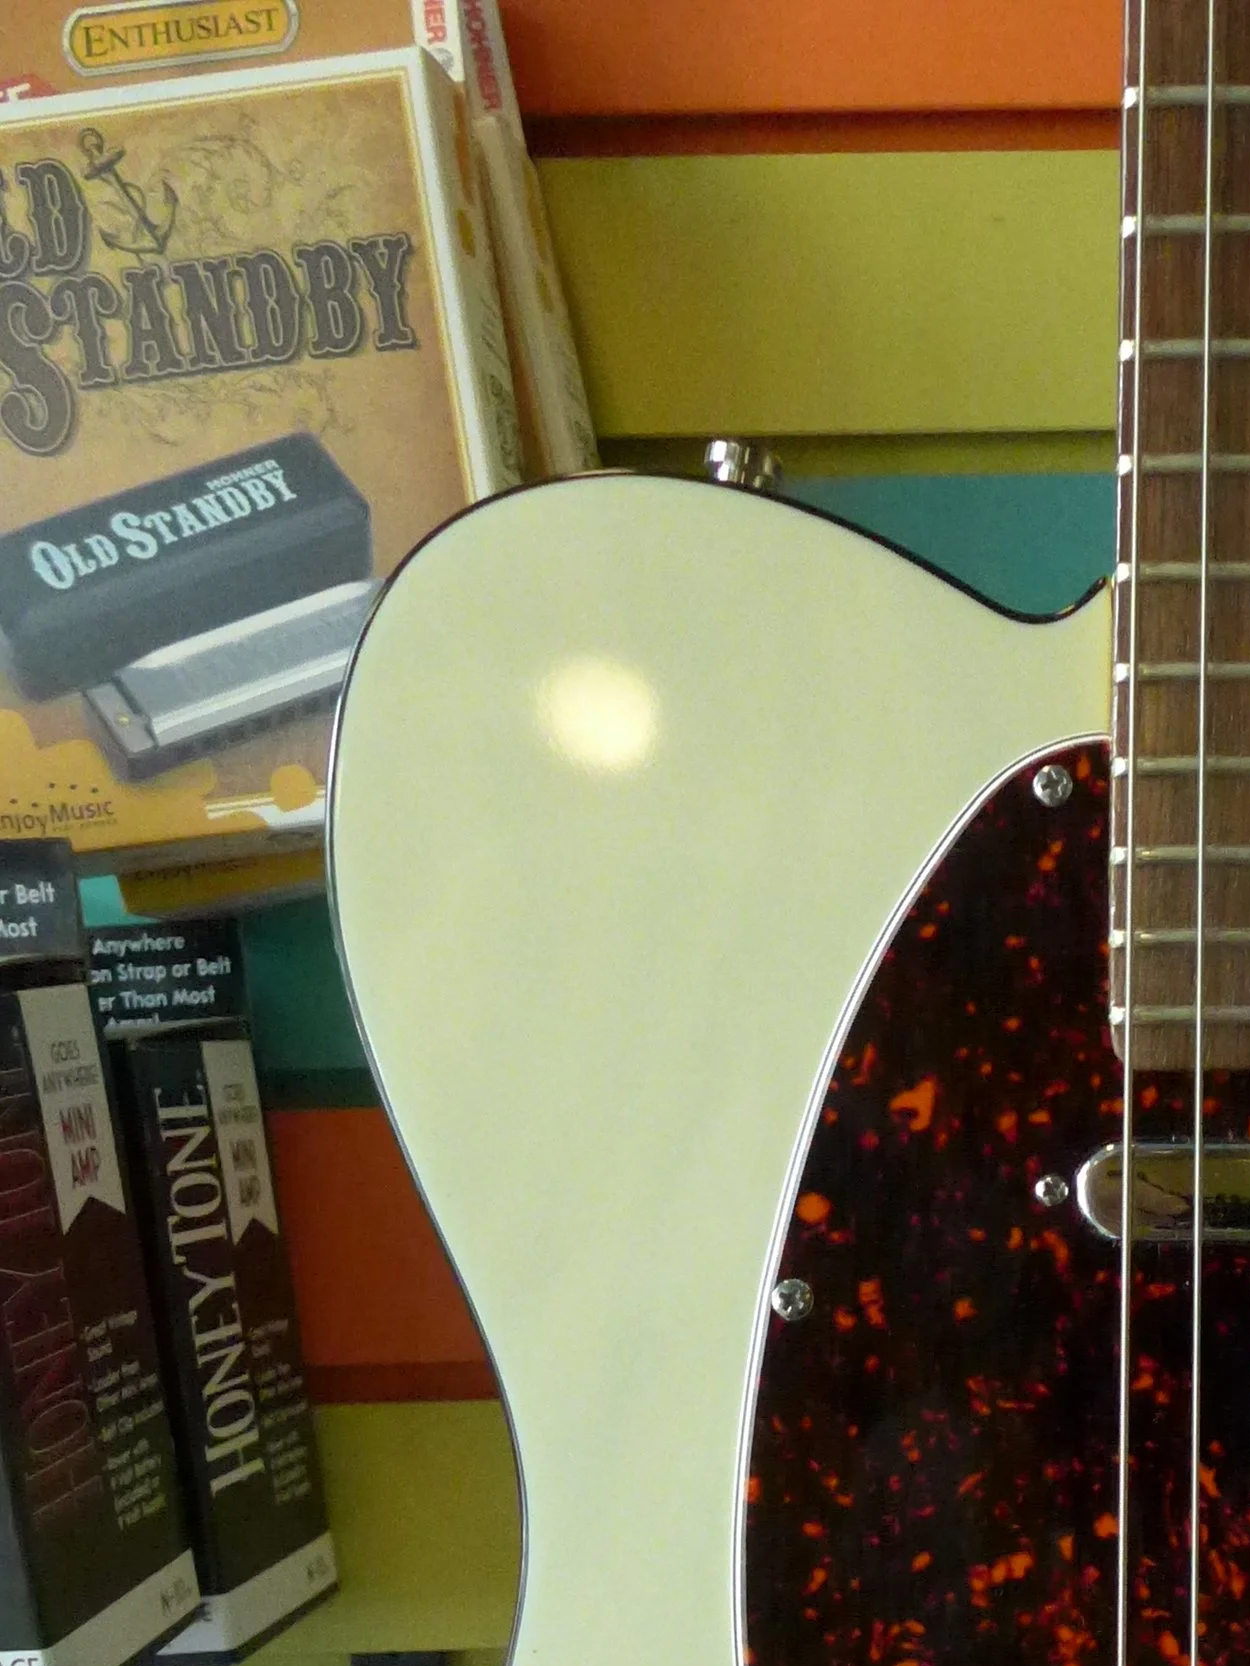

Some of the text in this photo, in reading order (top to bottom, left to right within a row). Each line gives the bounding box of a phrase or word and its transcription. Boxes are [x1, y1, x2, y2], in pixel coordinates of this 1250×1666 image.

[82, 7, 279, 58] ENTHUSIAST
[0, 233, 417, 456] STANDBY
[31, 469, 298, 590] OLD STANDBY
[15, 881, 55, 904] Belt
[92, 933, 185, 957] Anywhere
[117, 962, 167, 982] Strap
[172, 963, 192, 978] or
[196, 955, 232, 976] Belt
[119, 990, 167, 1009] Than
[172, 984, 216, 1005] Most
